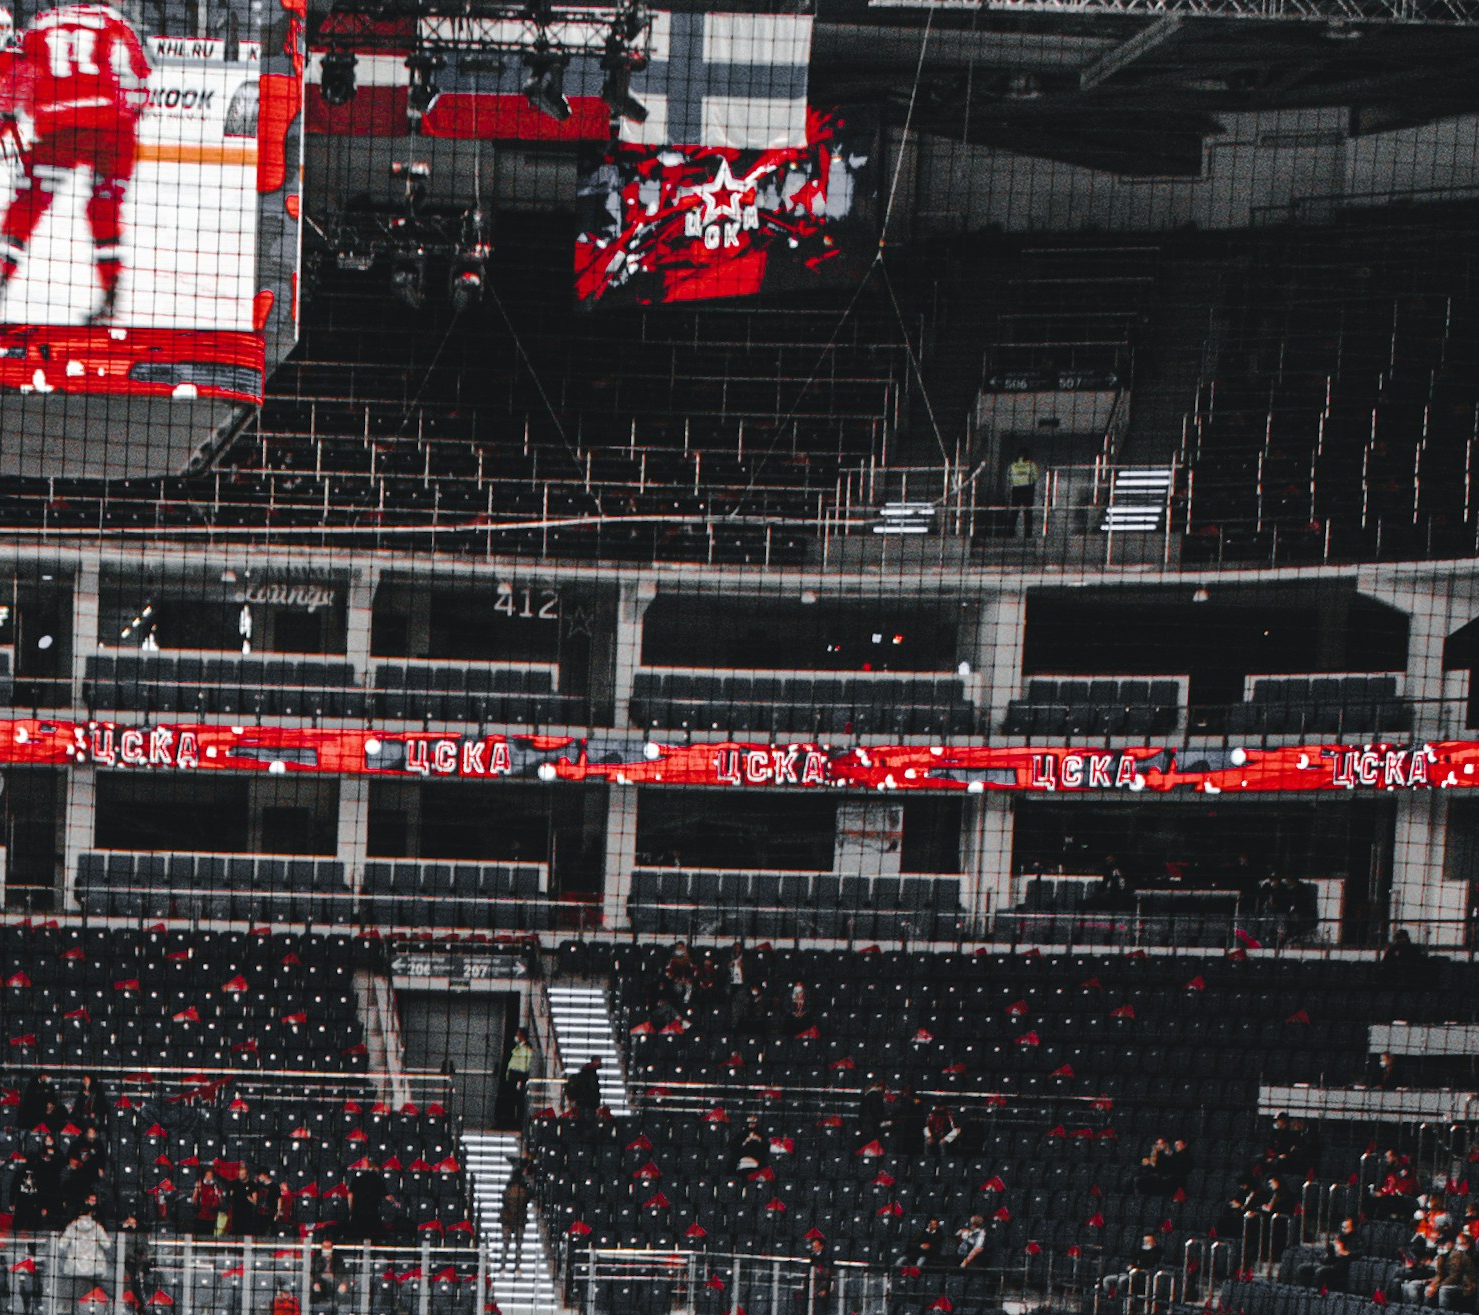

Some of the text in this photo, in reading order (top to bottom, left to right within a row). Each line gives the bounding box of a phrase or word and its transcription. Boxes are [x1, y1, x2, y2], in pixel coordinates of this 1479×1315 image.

[156, 40, 214, 58] KHL.RU
[493, 588, 560, 622] 412
[90, 725, 201, 767] ЦСКА
[404, 738, 513, 777] ЦСКА
[716, 749, 825, 788] ЦСКА
[1031, 752, 1140, 790] ЦСКА
[1331, 748, 1430, 788] ЦСКА
